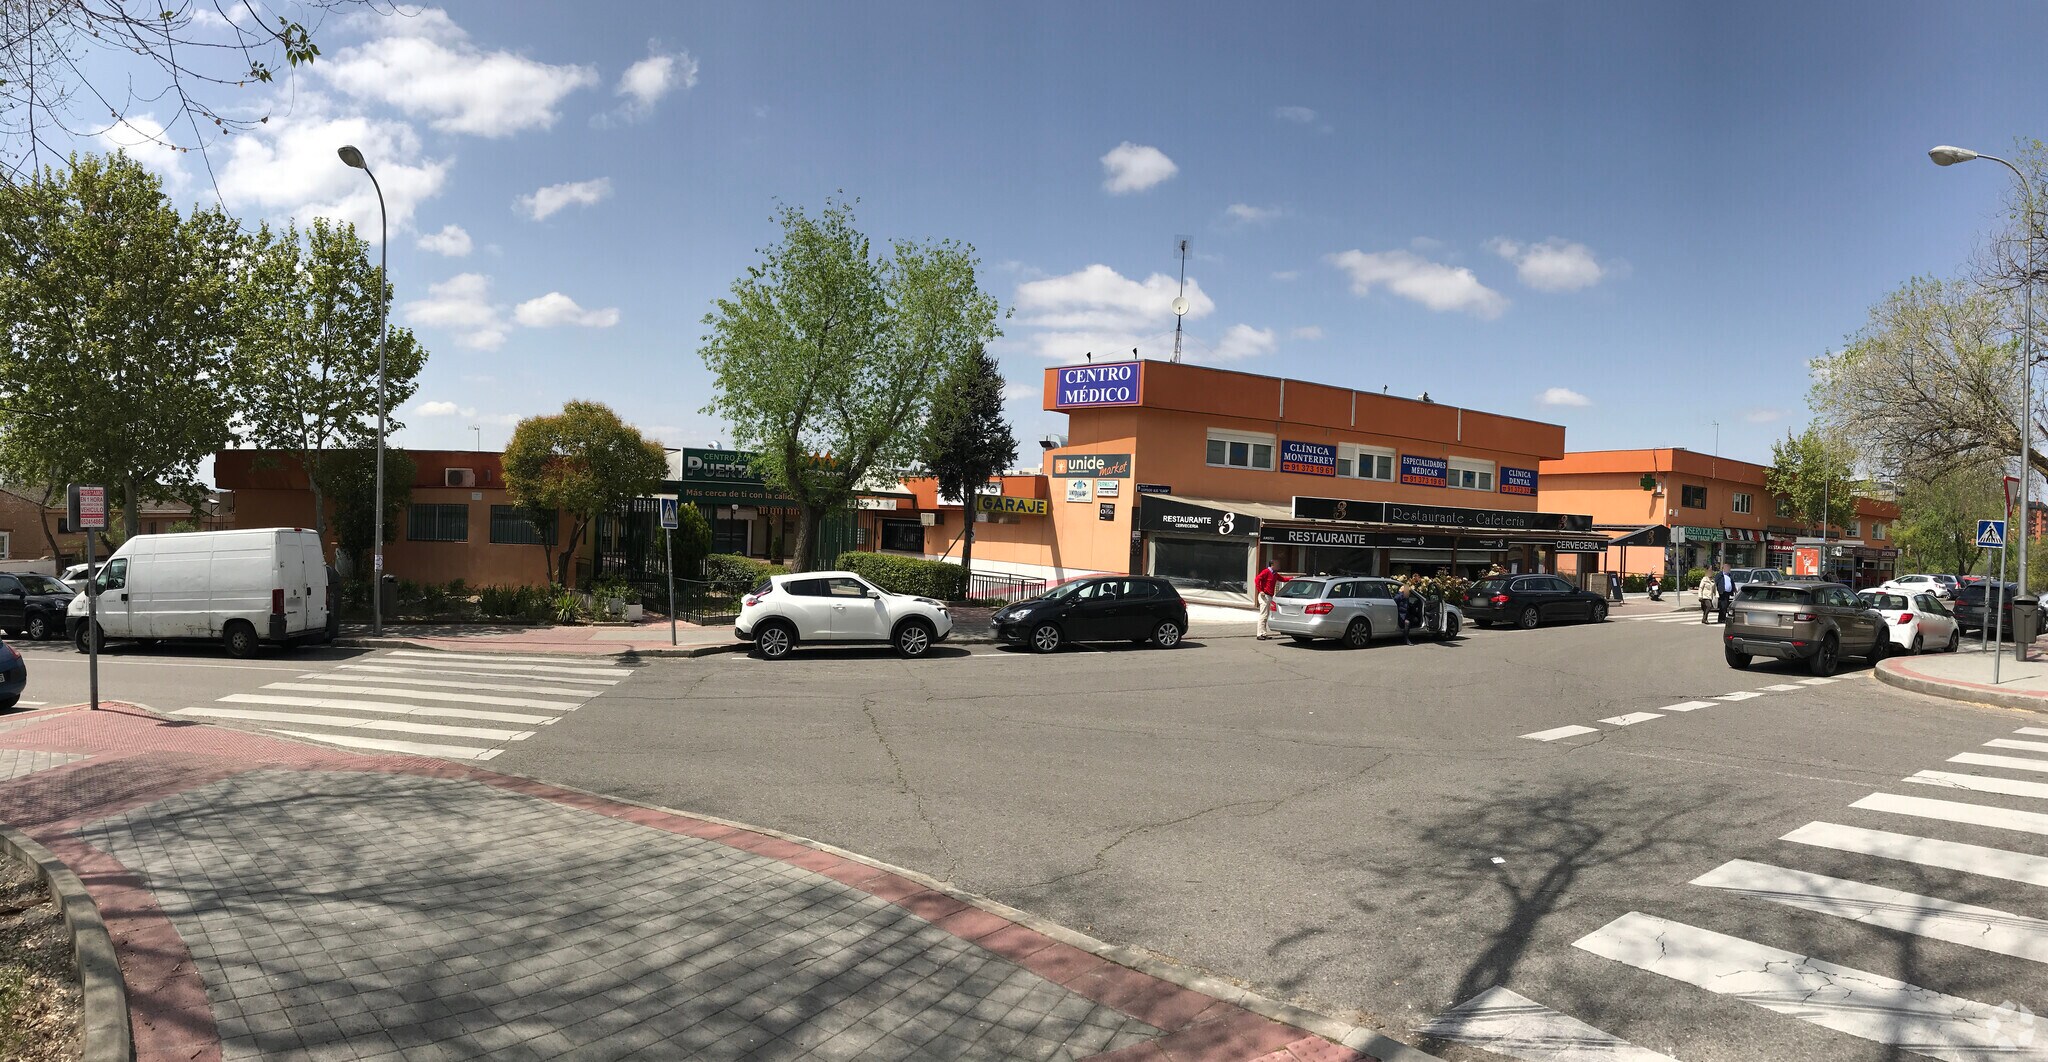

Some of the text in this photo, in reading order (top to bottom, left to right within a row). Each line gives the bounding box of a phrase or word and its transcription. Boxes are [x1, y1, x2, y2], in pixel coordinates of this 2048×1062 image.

[1065, 366, 1131, 384] CENTRO
[1064, 385, 1130, 403] MÉDICO
[1289, 443, 1330, 456] CLÍNICA
[703, 453, 735, 461] CENTRO
[1068, 456, 1105, 470] unide
[1283, 452, 1335, 465] MONTERREY
[1402, 457, 1447, 469] ESPECIALIDADES
[1099, 460, 1128, 476] market
[1302, 464, 1314, 472] 373
[1411, 466, 1438, 476] MÉDICAS
[1508, 469, 1531, 478] CLÍNICA
[1508, 478, 1530, 486] DENTAL
[982, 496, 1045, 513] GARAJE
[1162, 516, 1212, 524] RESTAURANTE
[1392, 508, 1464, 524] Restaurante
[1219, 512, 1235, 534] 3
[1288, 530, 1366, 544] RESTAURANTE
[1556, 540, 1599, 550] CERVECERIA
